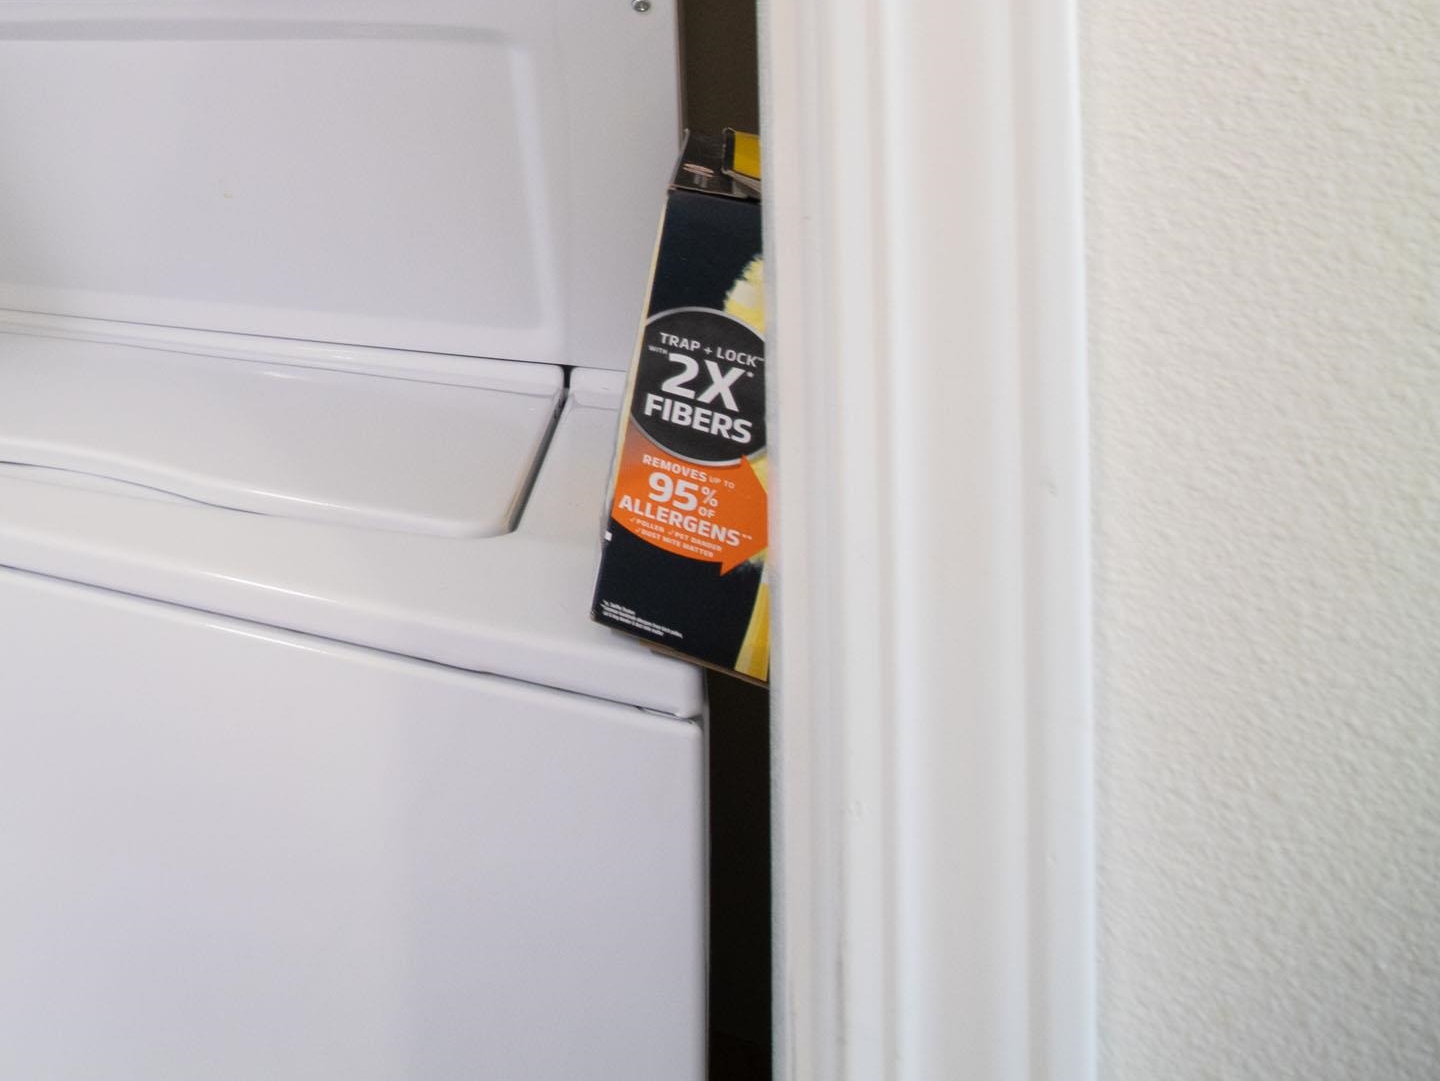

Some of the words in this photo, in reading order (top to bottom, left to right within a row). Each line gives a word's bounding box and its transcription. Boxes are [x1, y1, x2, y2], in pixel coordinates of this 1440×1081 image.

[648, 345, 668, 355] WITH
[660, 332, 701, 352] TRAP
[644, 393, 753, 444] FIBERS
[642, 454, 708, 482] REMOVES
[709, 476, 722, 485] UP
[724, 480, 736, 489] TO
[698, 506, 716, 519] OF
[636, 518, 665, 533] POLLEN
[682, 540, 714, 558] MATTER
